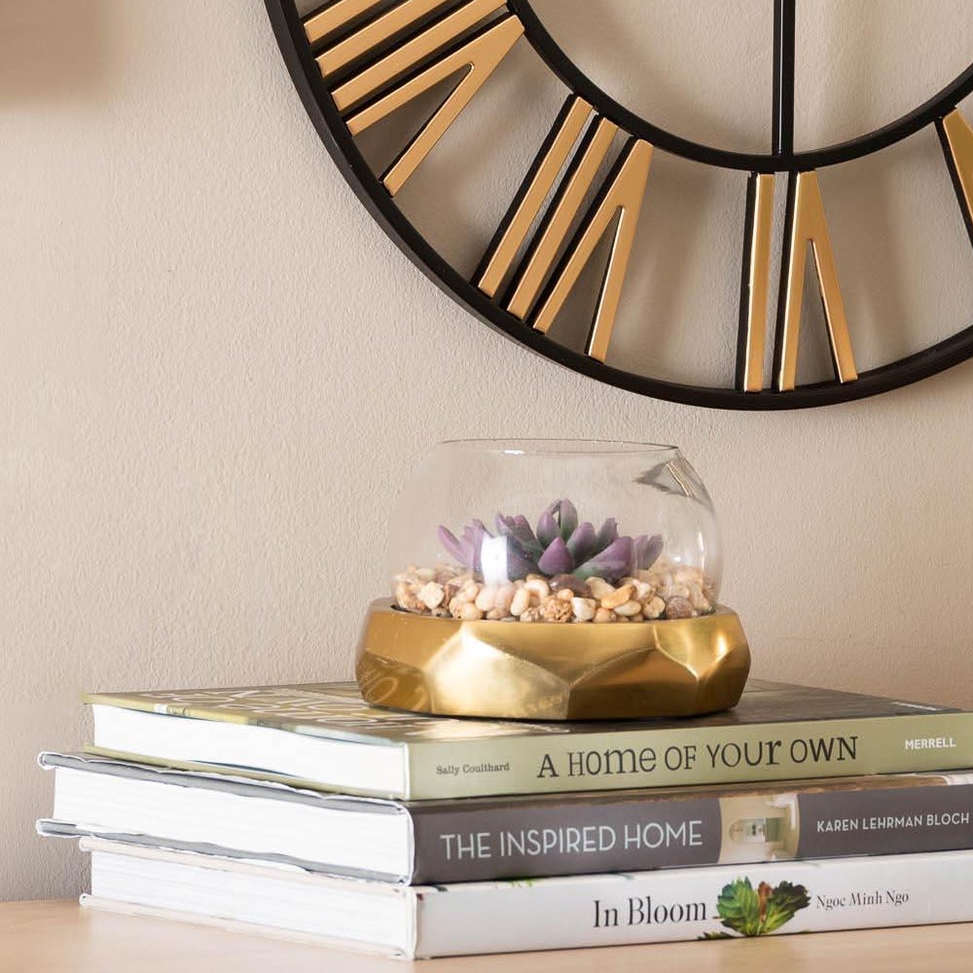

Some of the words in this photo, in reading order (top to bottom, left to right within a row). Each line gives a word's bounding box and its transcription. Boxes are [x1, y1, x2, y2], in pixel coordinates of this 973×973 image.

[470, 93, 654, 363] VII
[738, 169, 859, 394] VI
[536, 753, 560, 778] A
[664, 745, 697, 772] OF
[790, 735, 858, 765] OWN
[905, 737, 957, 751] MERRELL
[436, 764, 460, 776] Sally
[462, 762, 511, 774] Coulthard
[817, 819, 859, 833] KAREN
[862, 815, 923, 830] LEHRMAN
[926, 812, 970, 827] BLOCH
[440, 832, 492, 860] THE
[499, 825, 617, 857] INSPIRED
[624, 820, 703, 850] HOME
[593, 899, 618, 928] In
[628, 895, 707, 926] Bloom
[816, 894, 847, 911] Ngoc
[849, 892, 883, 907] Minh
[885, 890, 910, 907] Ngo
